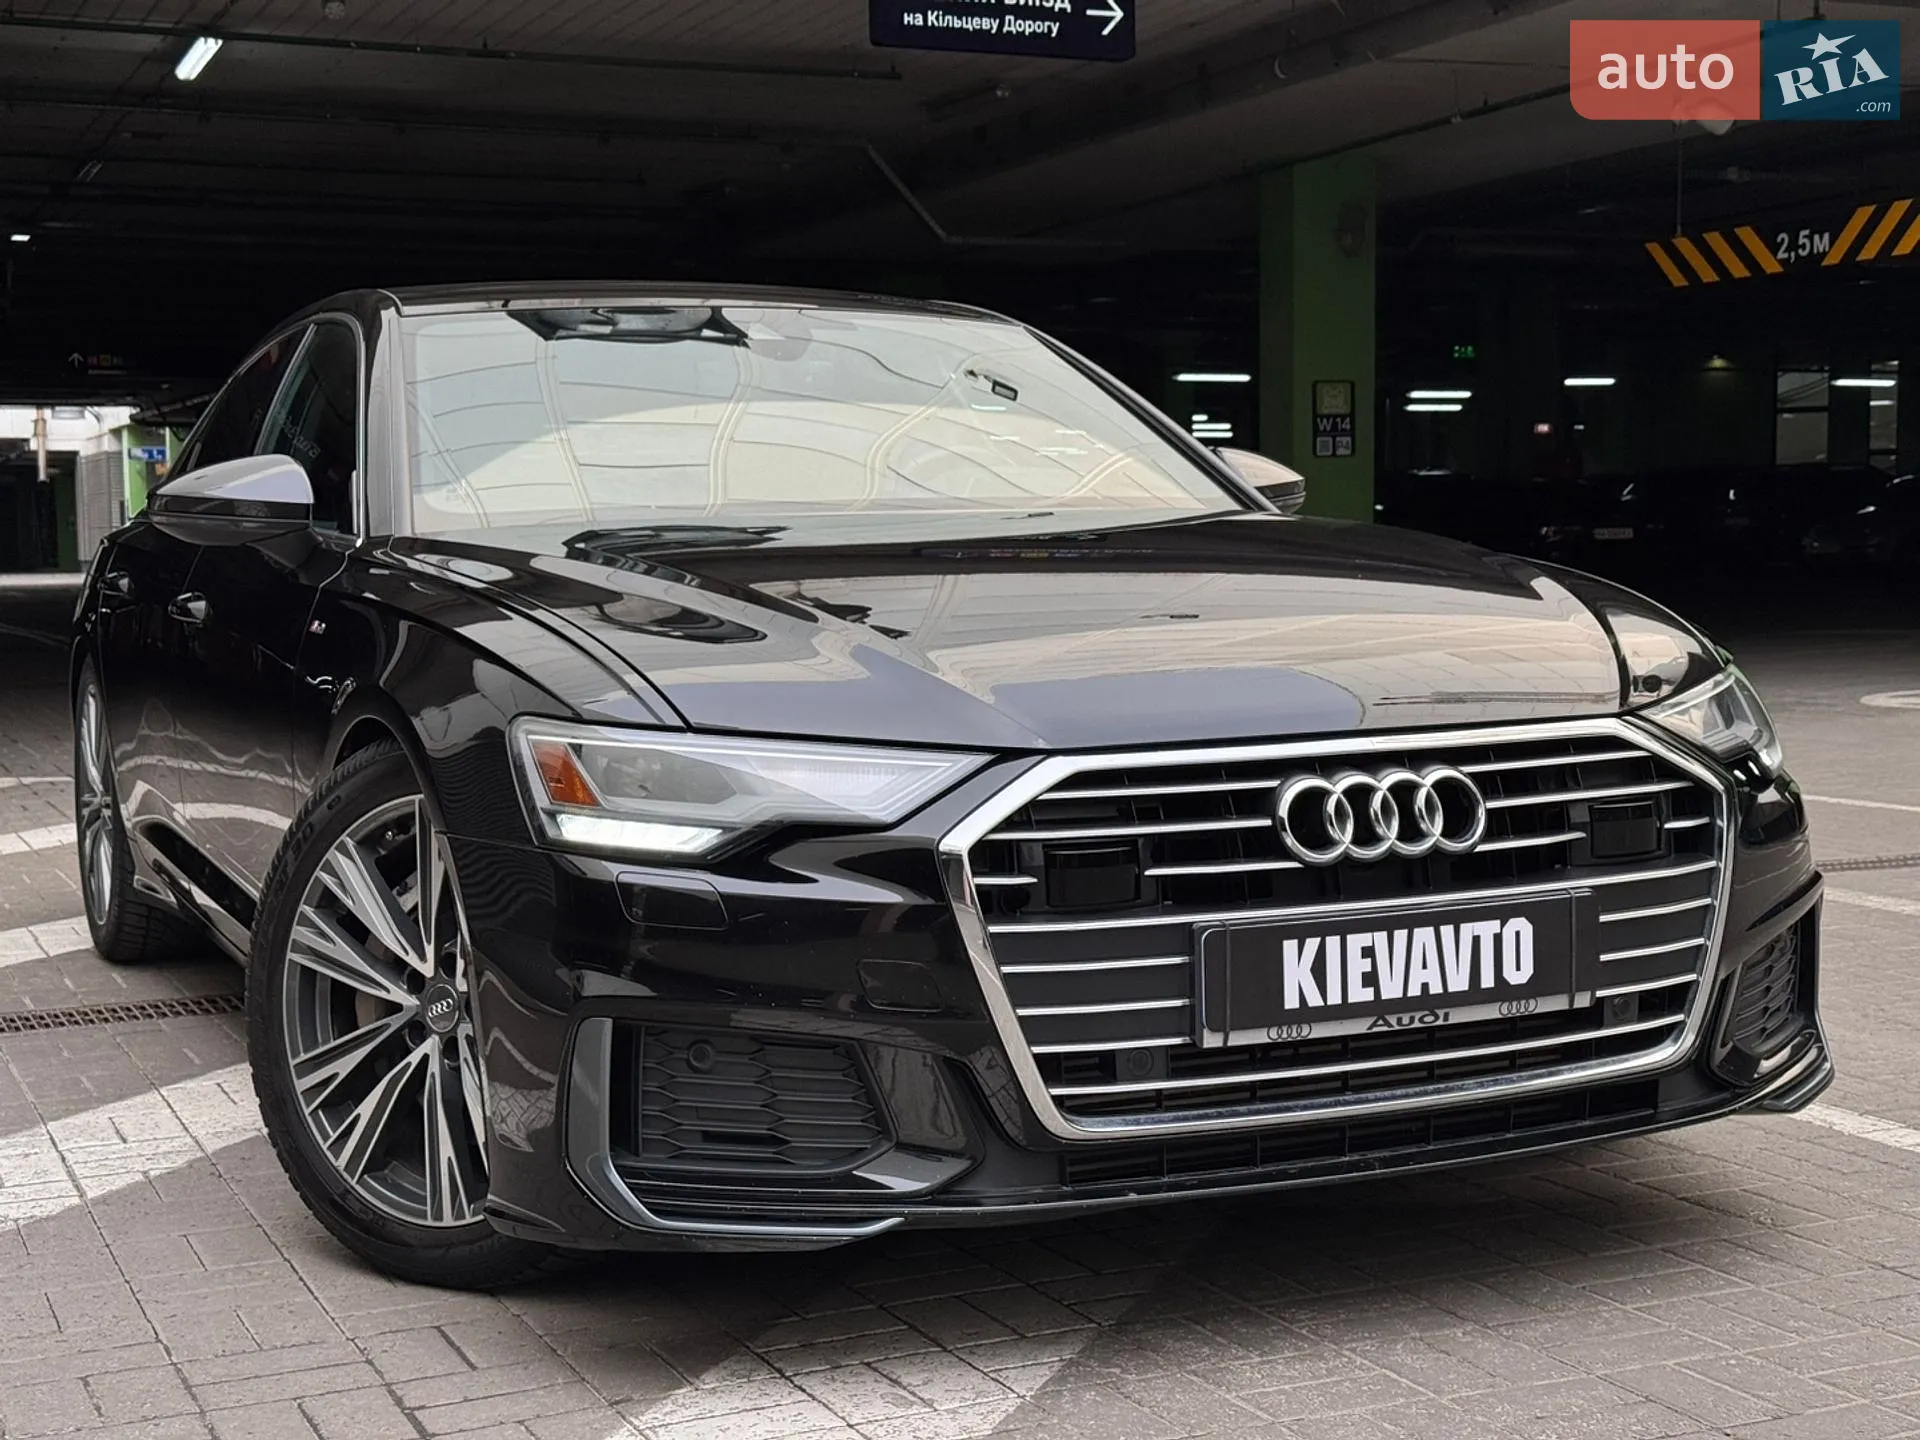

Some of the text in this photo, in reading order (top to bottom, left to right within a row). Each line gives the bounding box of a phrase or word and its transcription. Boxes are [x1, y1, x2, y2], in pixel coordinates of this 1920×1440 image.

[903, 10, 1060, 37] на Кільцеву Дорогу
[1316, 416, 1351, 431] W 14
[1282, 916, 1534, 1010] KIEVAVTO
[1366, 1009, 1450, 1031] Audi
